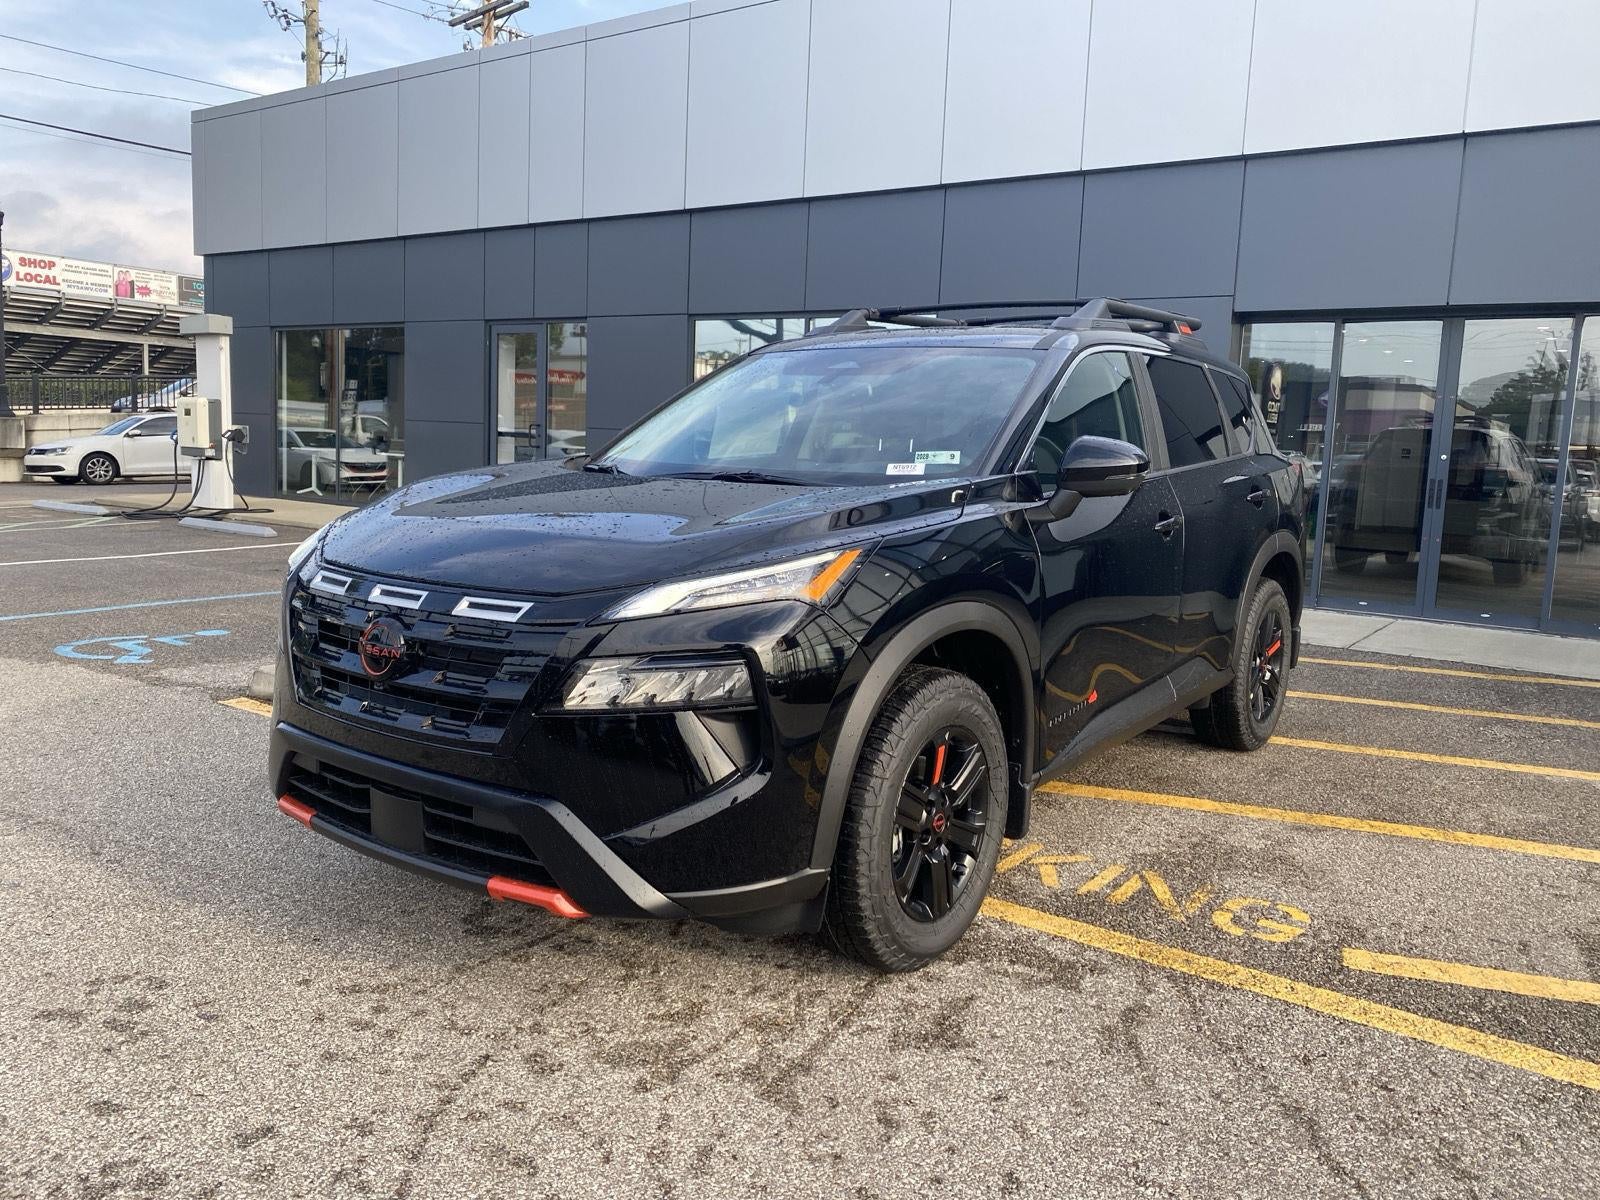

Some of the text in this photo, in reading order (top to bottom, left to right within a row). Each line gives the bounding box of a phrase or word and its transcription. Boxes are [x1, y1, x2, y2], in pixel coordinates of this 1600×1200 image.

[18, 256, 56, 270] SHOP
[15, 271, 61, 286] LOCAL
[994, 838, 1310, 942] KING
